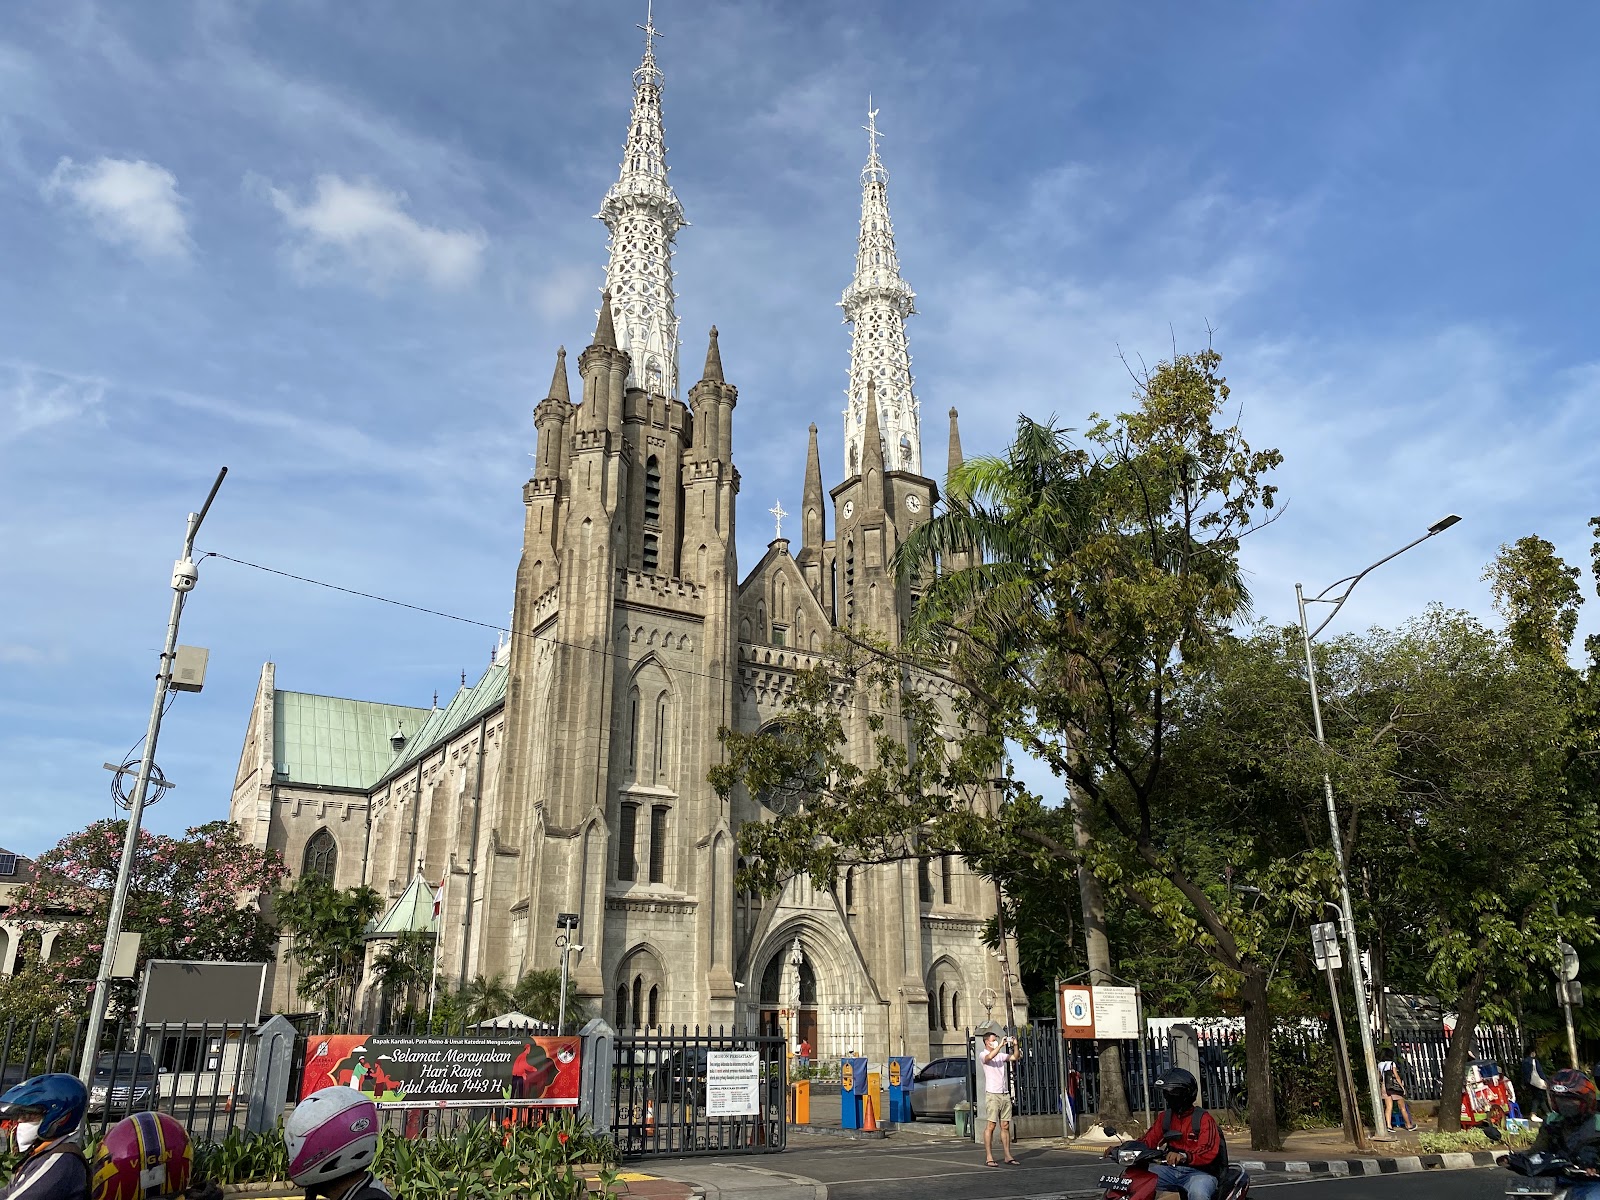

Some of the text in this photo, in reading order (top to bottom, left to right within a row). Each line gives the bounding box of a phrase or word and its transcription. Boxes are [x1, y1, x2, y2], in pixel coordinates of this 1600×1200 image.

[391, 1047, 511, 1066] Selamat Merayakan
[420, 1064, 482, 1081] Hari Raya
[397, 1079, 502, 1094] Idul Adha 1443 H
